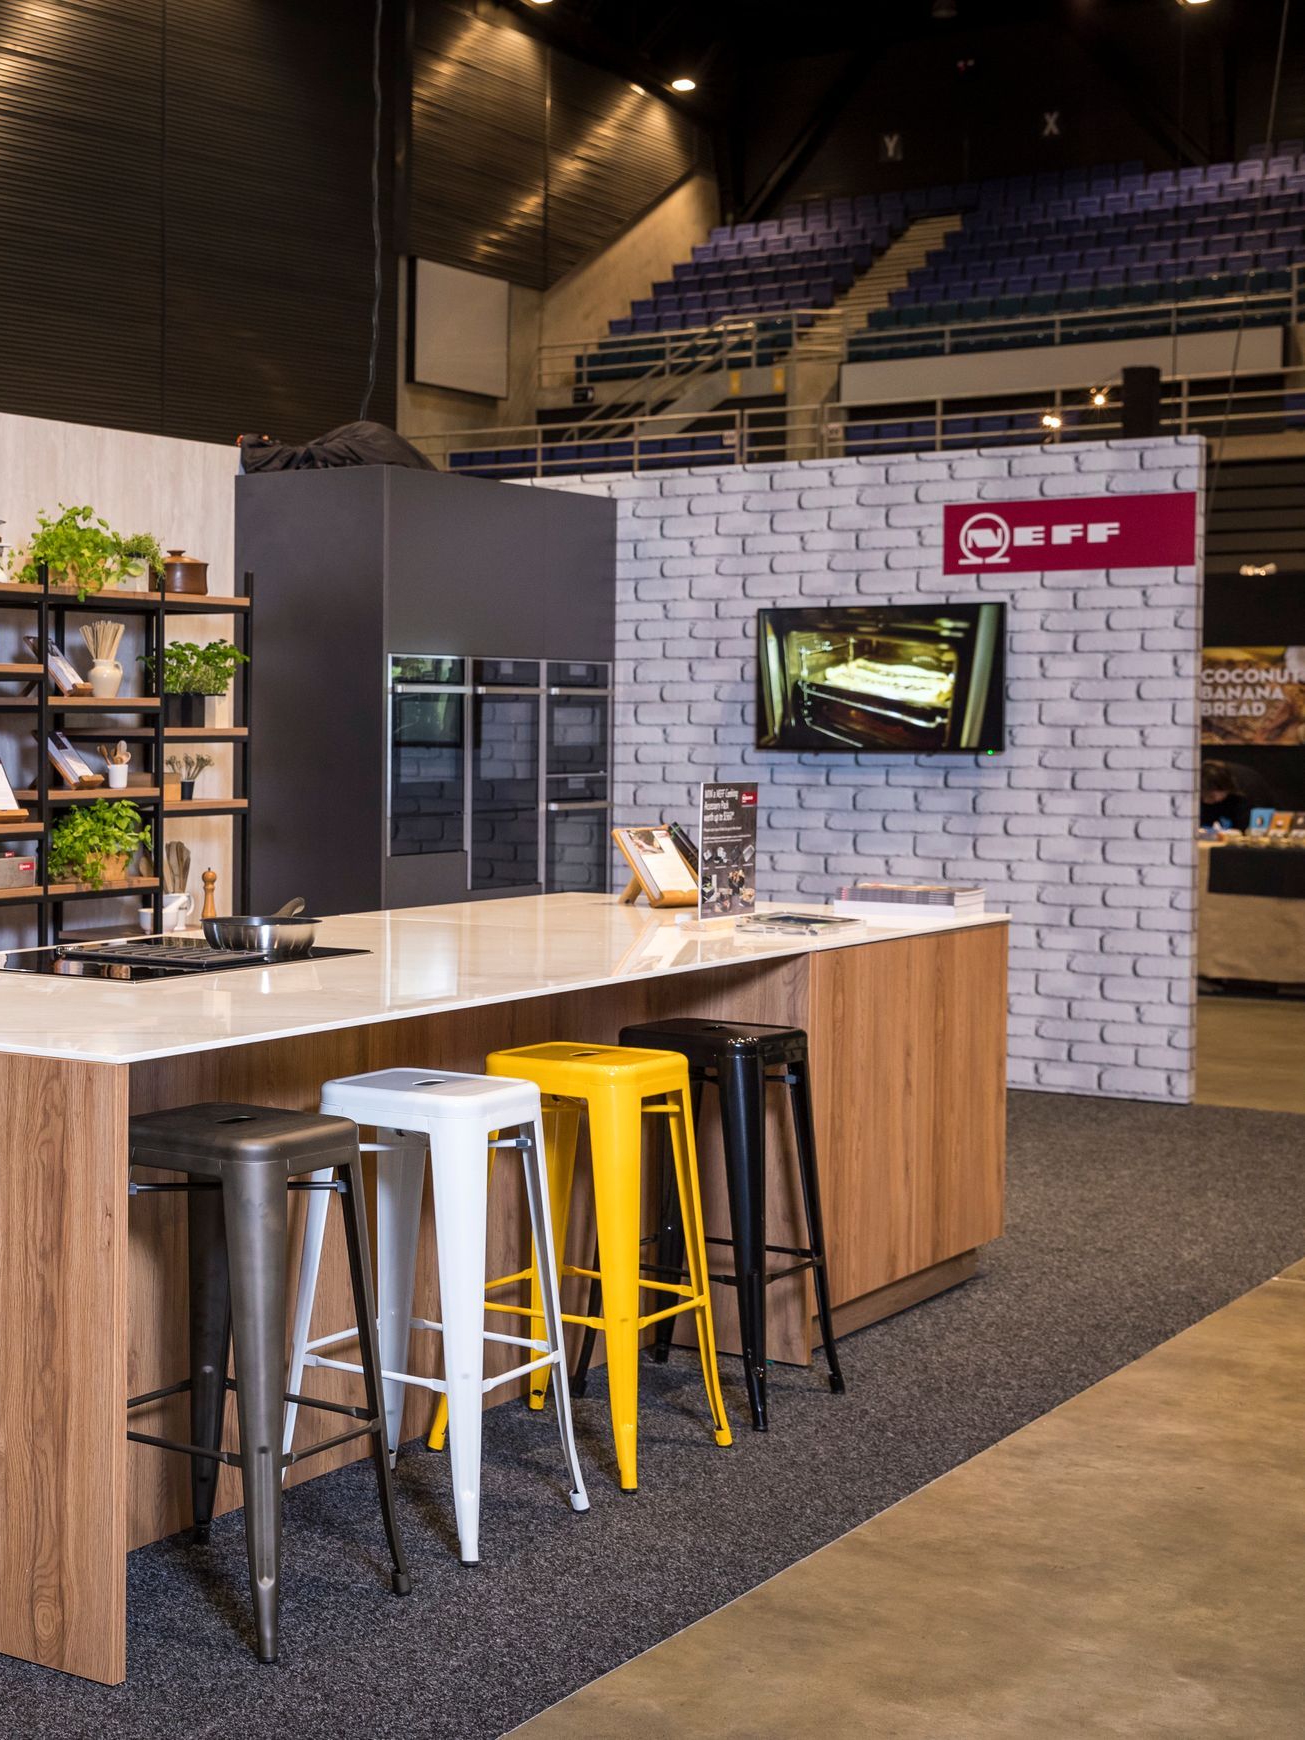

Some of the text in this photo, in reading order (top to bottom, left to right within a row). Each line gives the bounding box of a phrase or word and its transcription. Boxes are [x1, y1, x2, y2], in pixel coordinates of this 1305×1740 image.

[1043, 112, 1059, 135] X
[884, 134, 899, 158] Y
[958, 512, 1120, 565] NEFF
[1201, 685, 1283, 700] BANANA
[1201, 701, 1266, 717] BREAD
